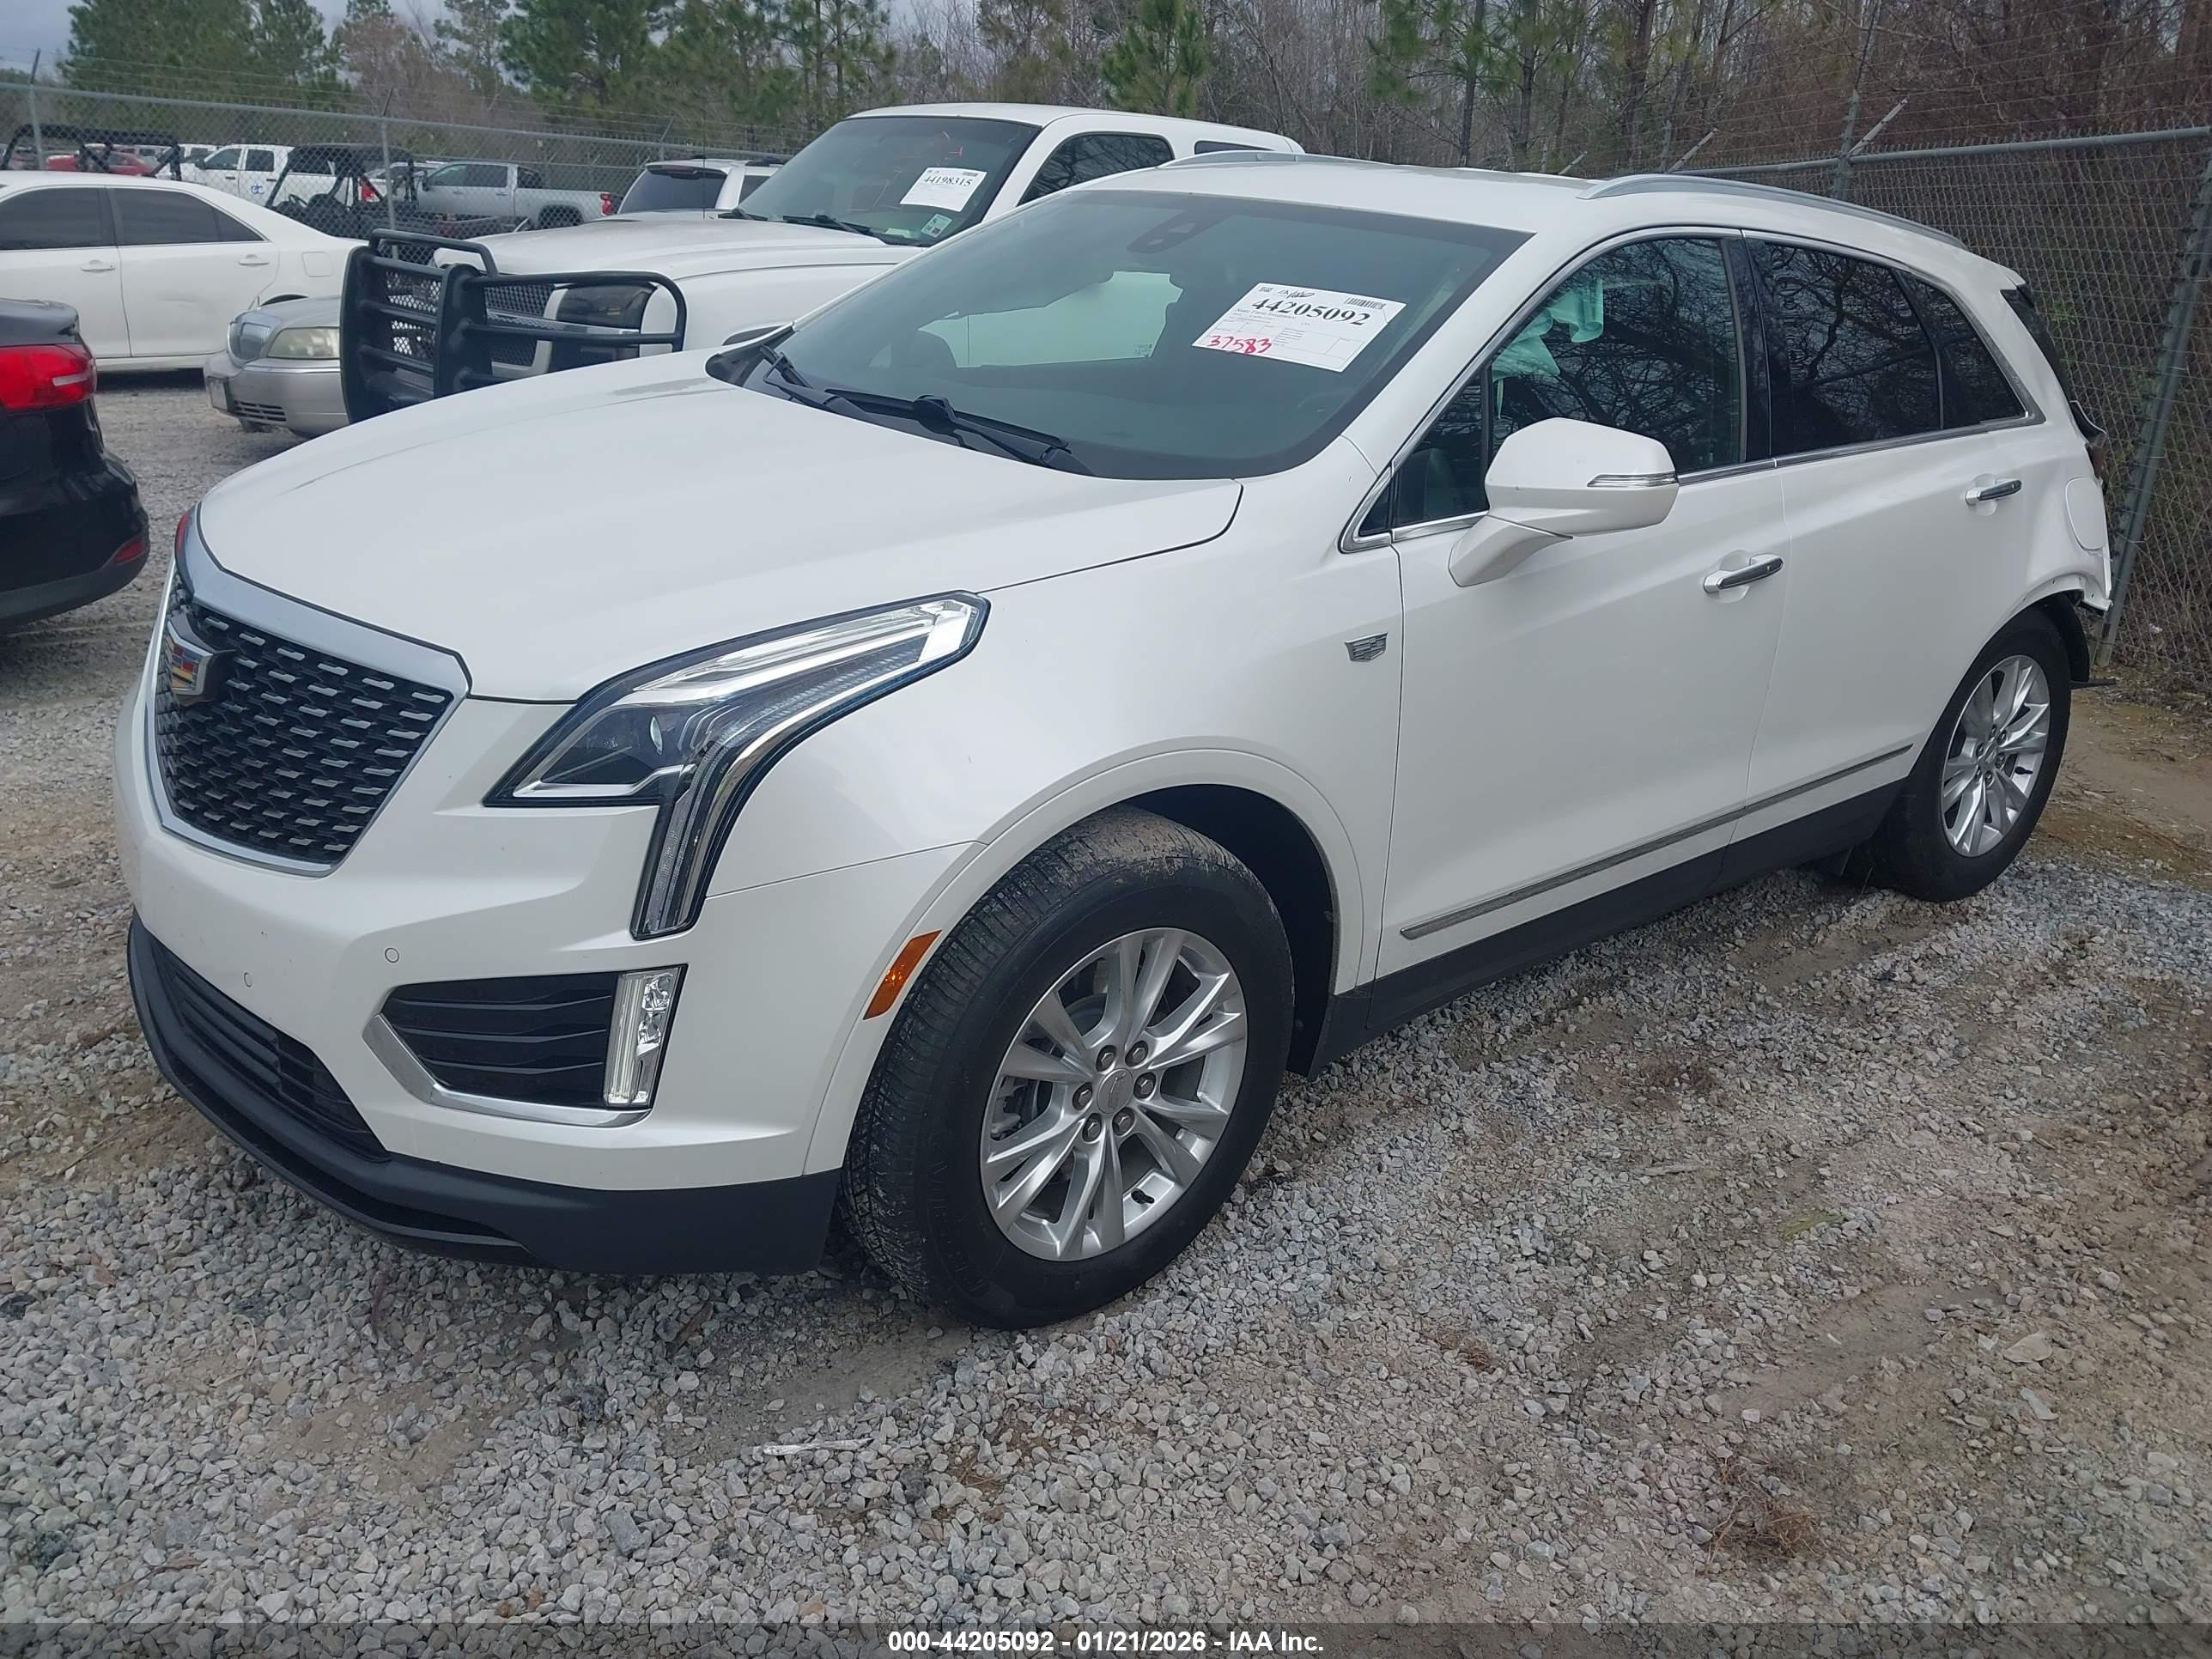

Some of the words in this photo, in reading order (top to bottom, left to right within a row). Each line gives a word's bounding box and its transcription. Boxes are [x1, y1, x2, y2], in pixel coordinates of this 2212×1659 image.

[924, 176, 973, 185] 44198315
[1252, 298, 1371, 325] 44205092
[1207, 335, 1273, 354] 37583
